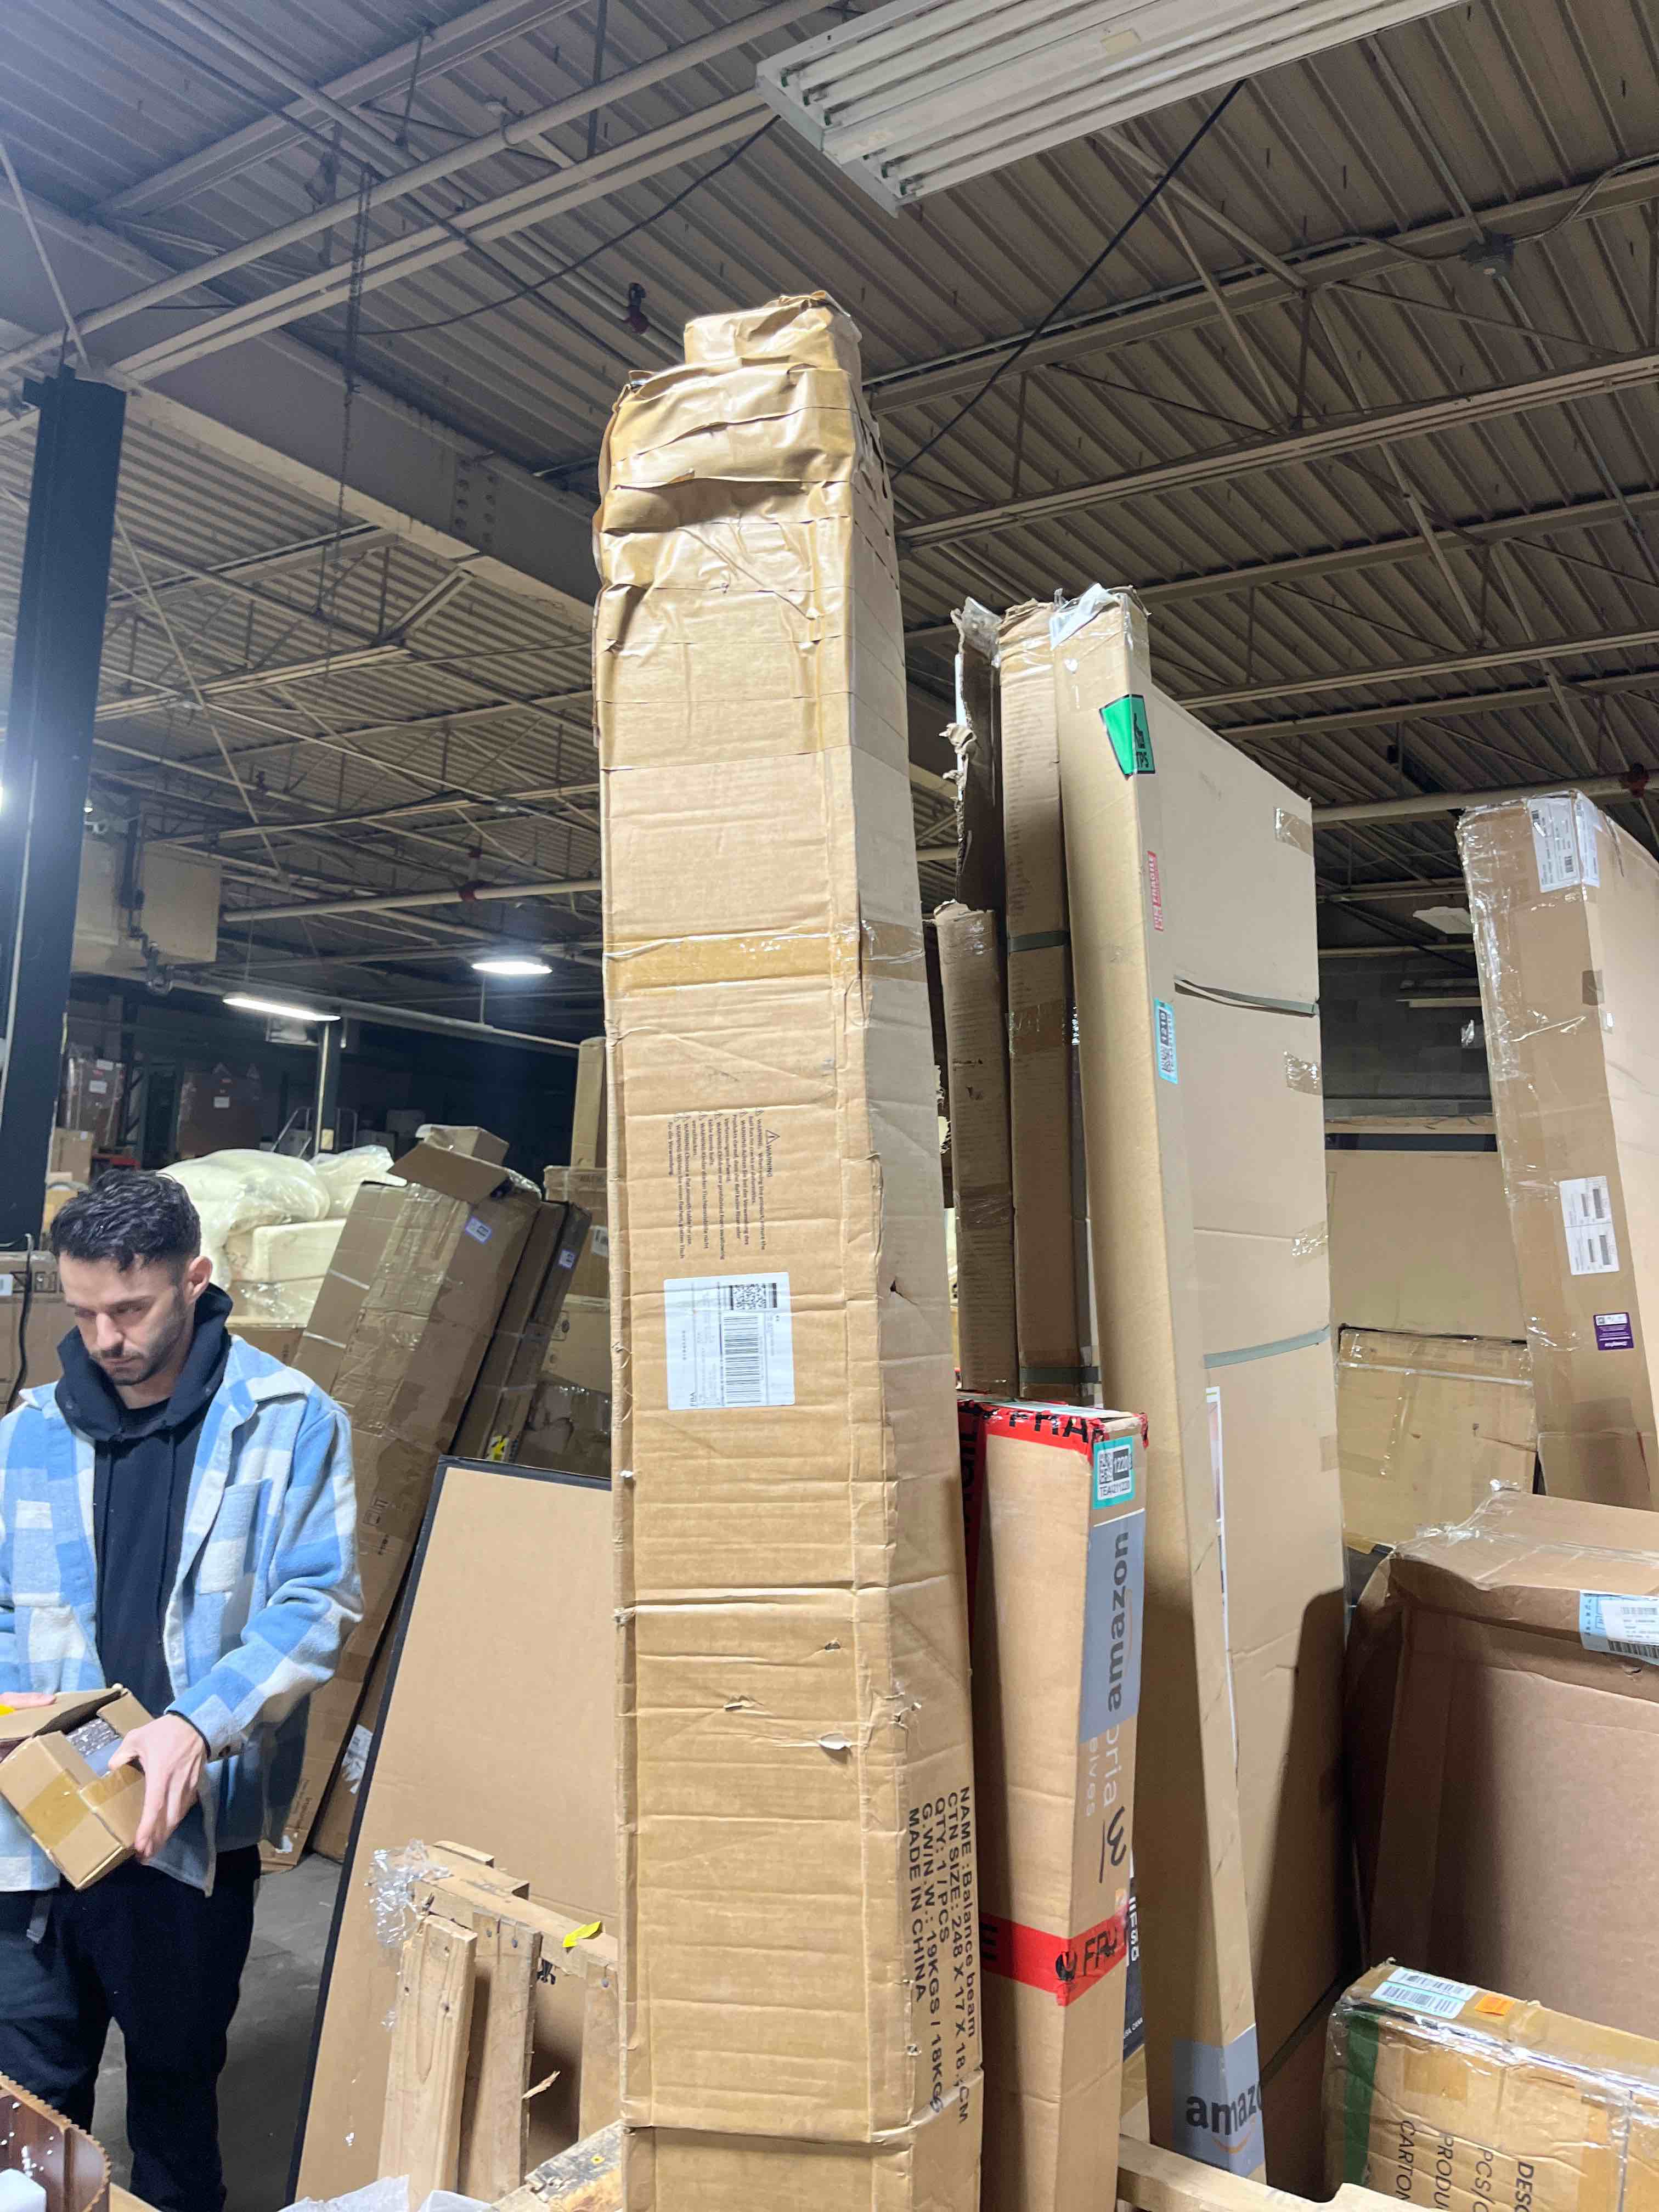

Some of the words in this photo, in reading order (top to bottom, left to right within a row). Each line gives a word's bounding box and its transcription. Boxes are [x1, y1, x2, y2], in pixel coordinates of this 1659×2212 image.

[1107, 1532, 1130, 1712] amazon
[909, 1808, 921, 1881] MADE
[935, 1797, 946, 1854] QTY:
[948, 1792, 958, 1841] CTN
[911, 1886, 922, 1913] IN
[949, 1847, 960, 1911] SIZE:
[960, 1786, 972, 1855] NAME
[966, 1972, 975, 2038] beam
[912, 1918, 927, 2002] CHINA
[951, 1915, 964, 1959] 248
[927, 1930, 940, 2014] 19KGS
[955, 1986, 965, 2011] 17
[1434, 2135, 1454, 2209] PRODU
